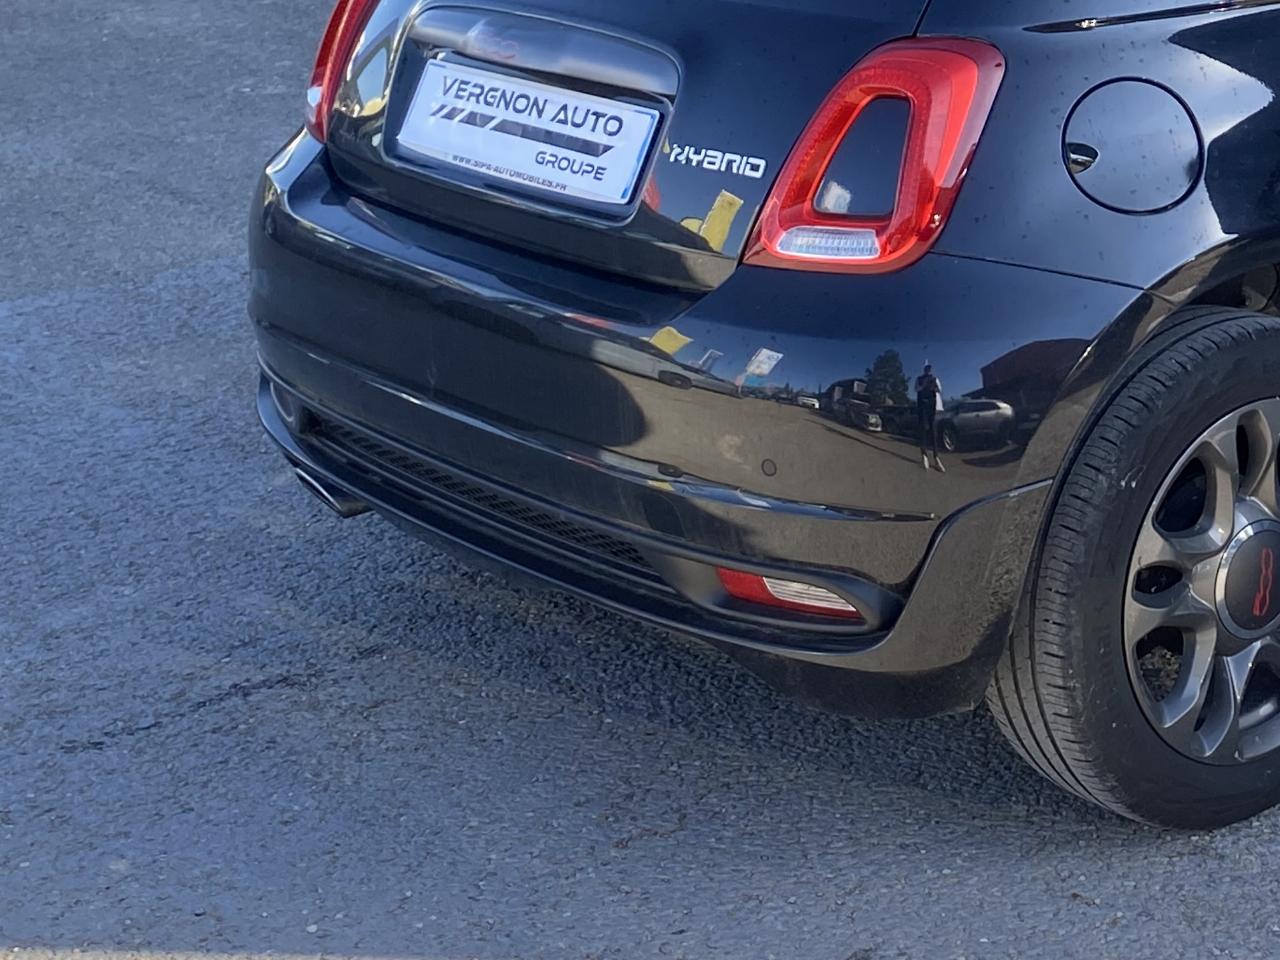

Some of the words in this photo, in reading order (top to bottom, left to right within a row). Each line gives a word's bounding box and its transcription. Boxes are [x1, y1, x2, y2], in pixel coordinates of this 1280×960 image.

[442, 74, 549, 119] VERGNON
[550, 103, 623, 137] AUTO
[534, 150, 608, 182] GROUPE
[669, 143, 767, 179] HYBRID
